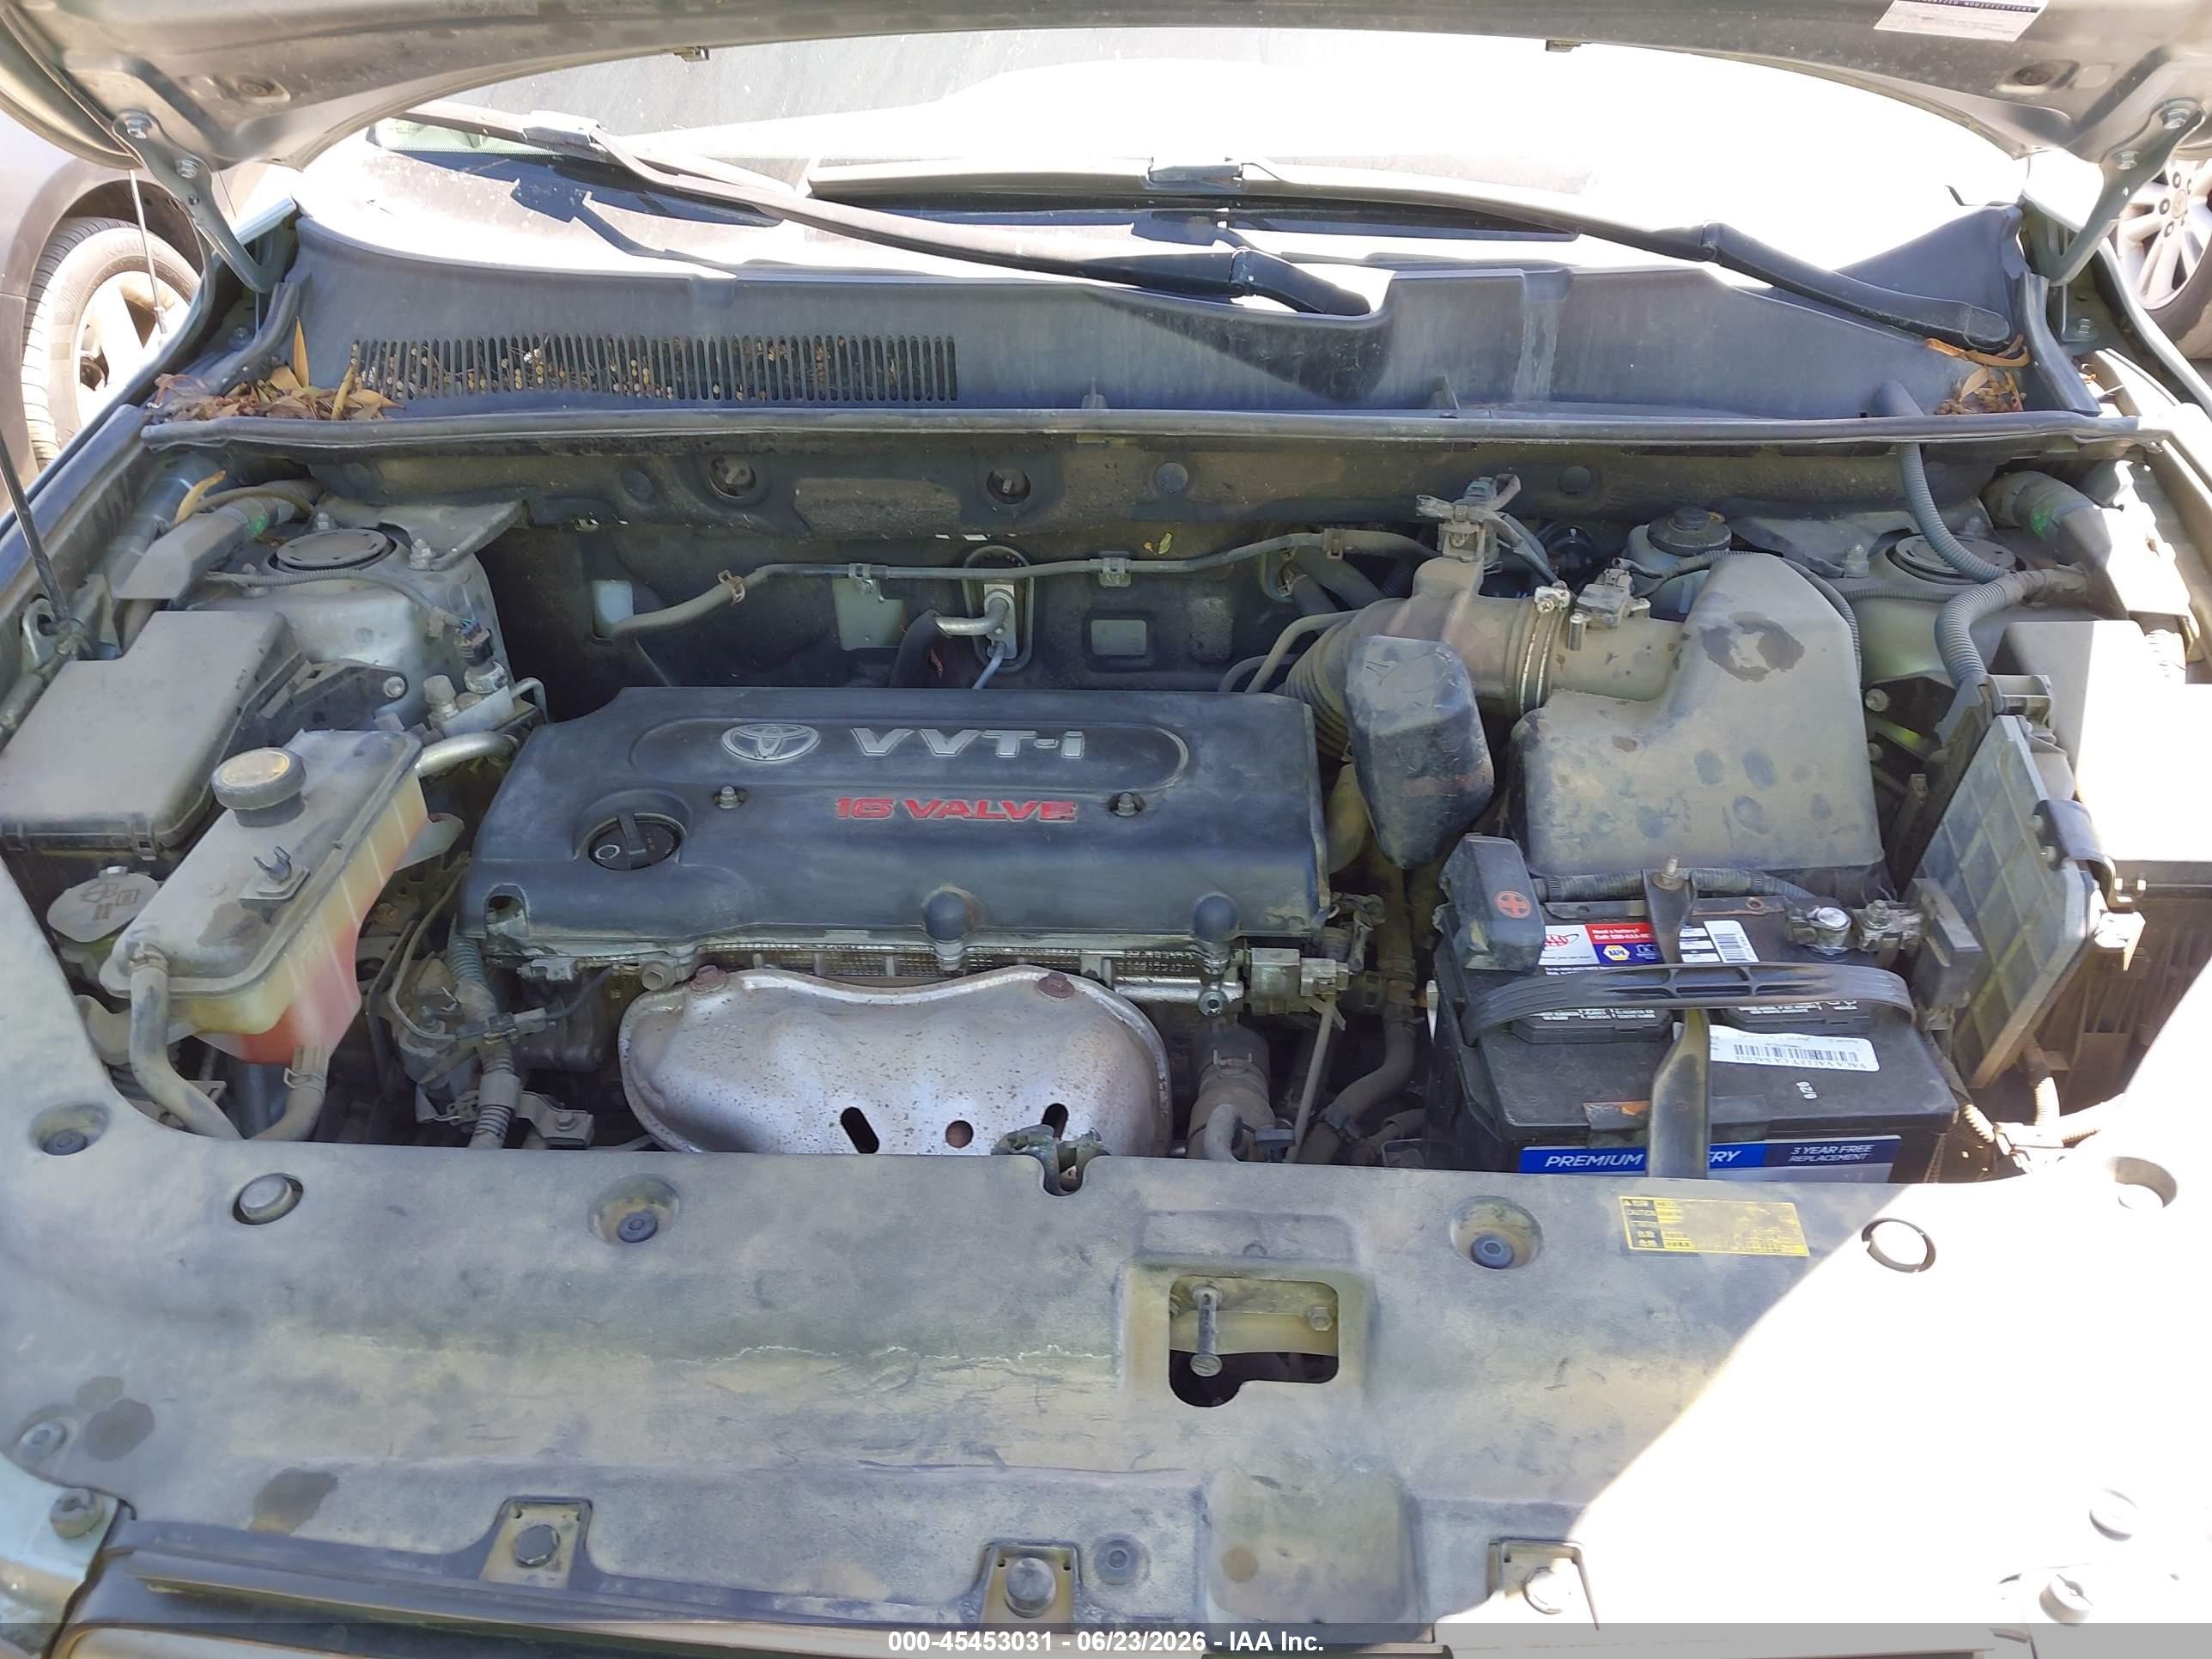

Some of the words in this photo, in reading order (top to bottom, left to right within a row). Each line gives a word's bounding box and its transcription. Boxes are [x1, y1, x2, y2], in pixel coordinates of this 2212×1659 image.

[1964, 1, 2033, 11] MODIFICATIONS
[852, 727, 1085, 758] VVT-i
[835, 797, 894, 819] 16
[904, 799, 1079, 822] VALVE
[1792, 1059, 1832, 1067] VALLEY
[1790, 1146, 1802, 1155] 3
[1803, 1146, 1839, 1155] YEAR
[1838, 1144, 1876, 1153] FREE
[1545, 1153, 1644, 1168] PREMIUM
[1788, 1152, 1869, 1162] REPLACEMENT
